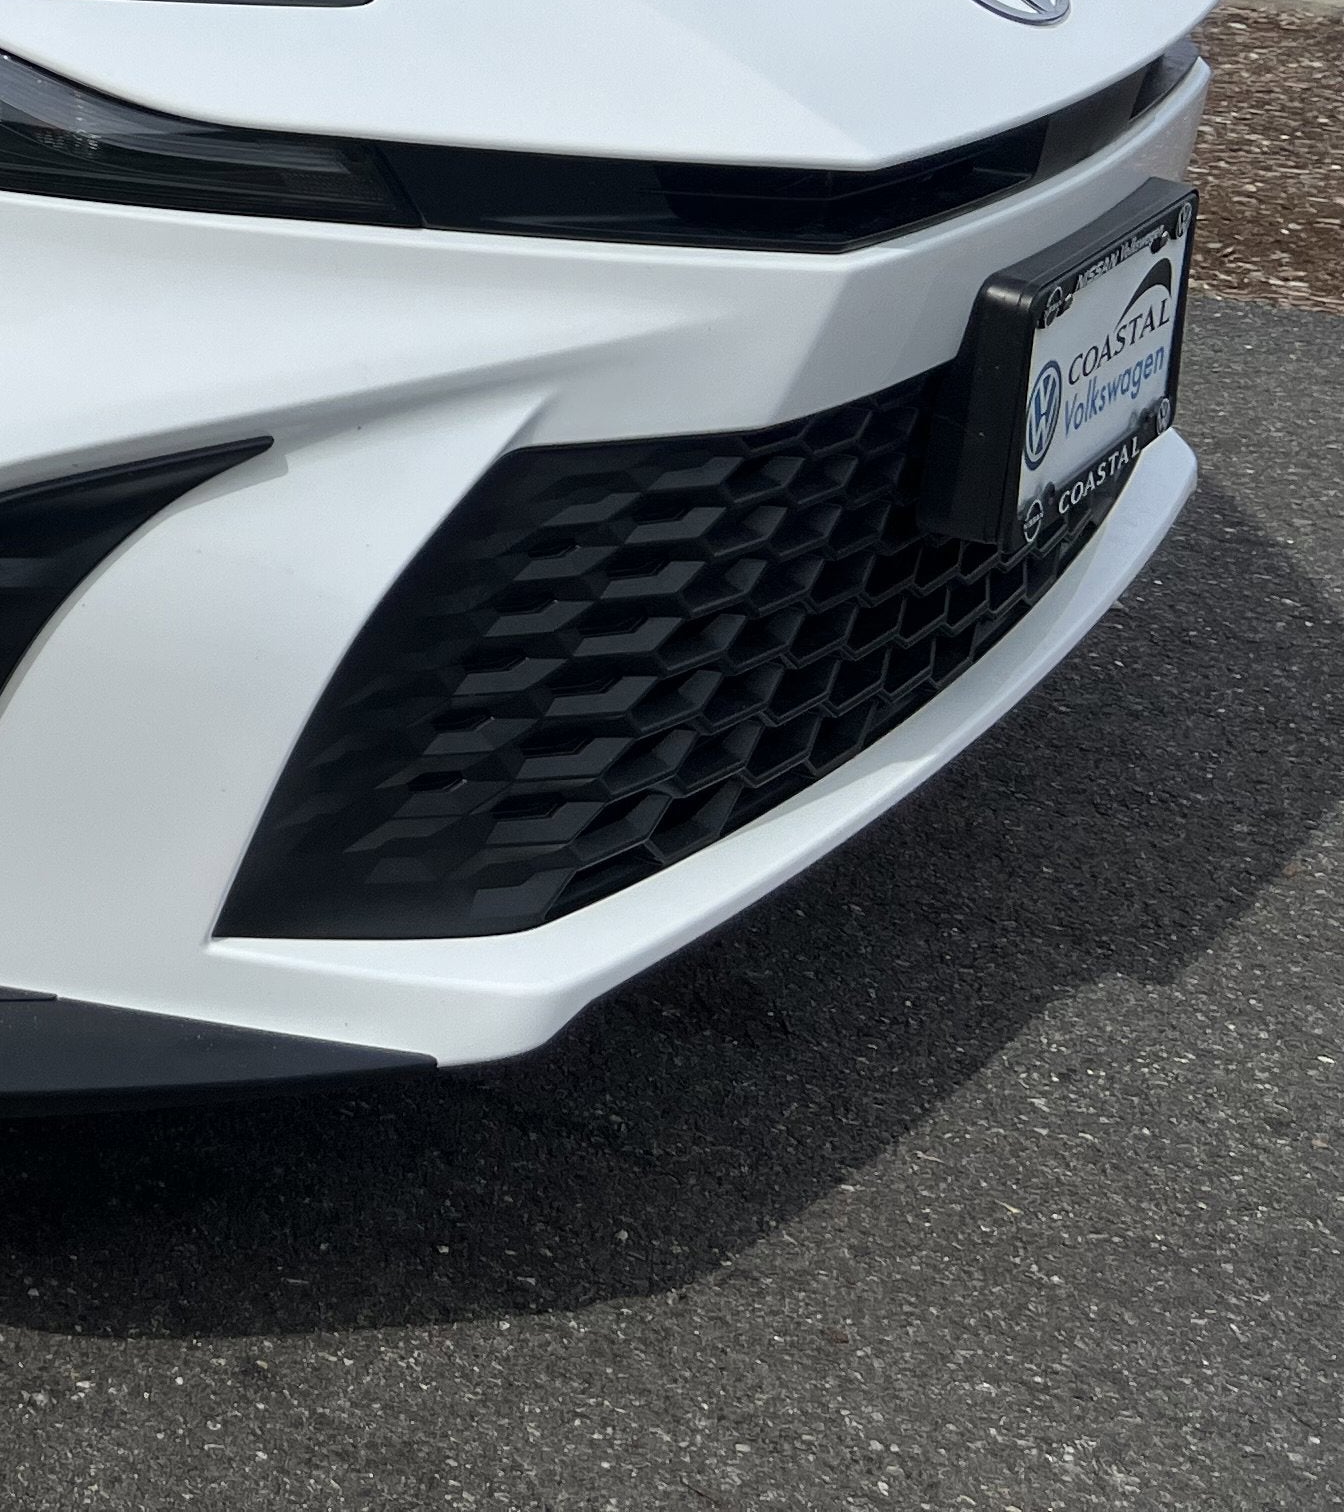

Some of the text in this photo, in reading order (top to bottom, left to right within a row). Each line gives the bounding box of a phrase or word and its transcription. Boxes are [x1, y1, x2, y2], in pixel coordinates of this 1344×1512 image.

[1068, 297, 1170, 386] COASTAL
[1064, 346, 1165, 437] Volkswagen
[1058, 436, 1140, 514] COASTAL
